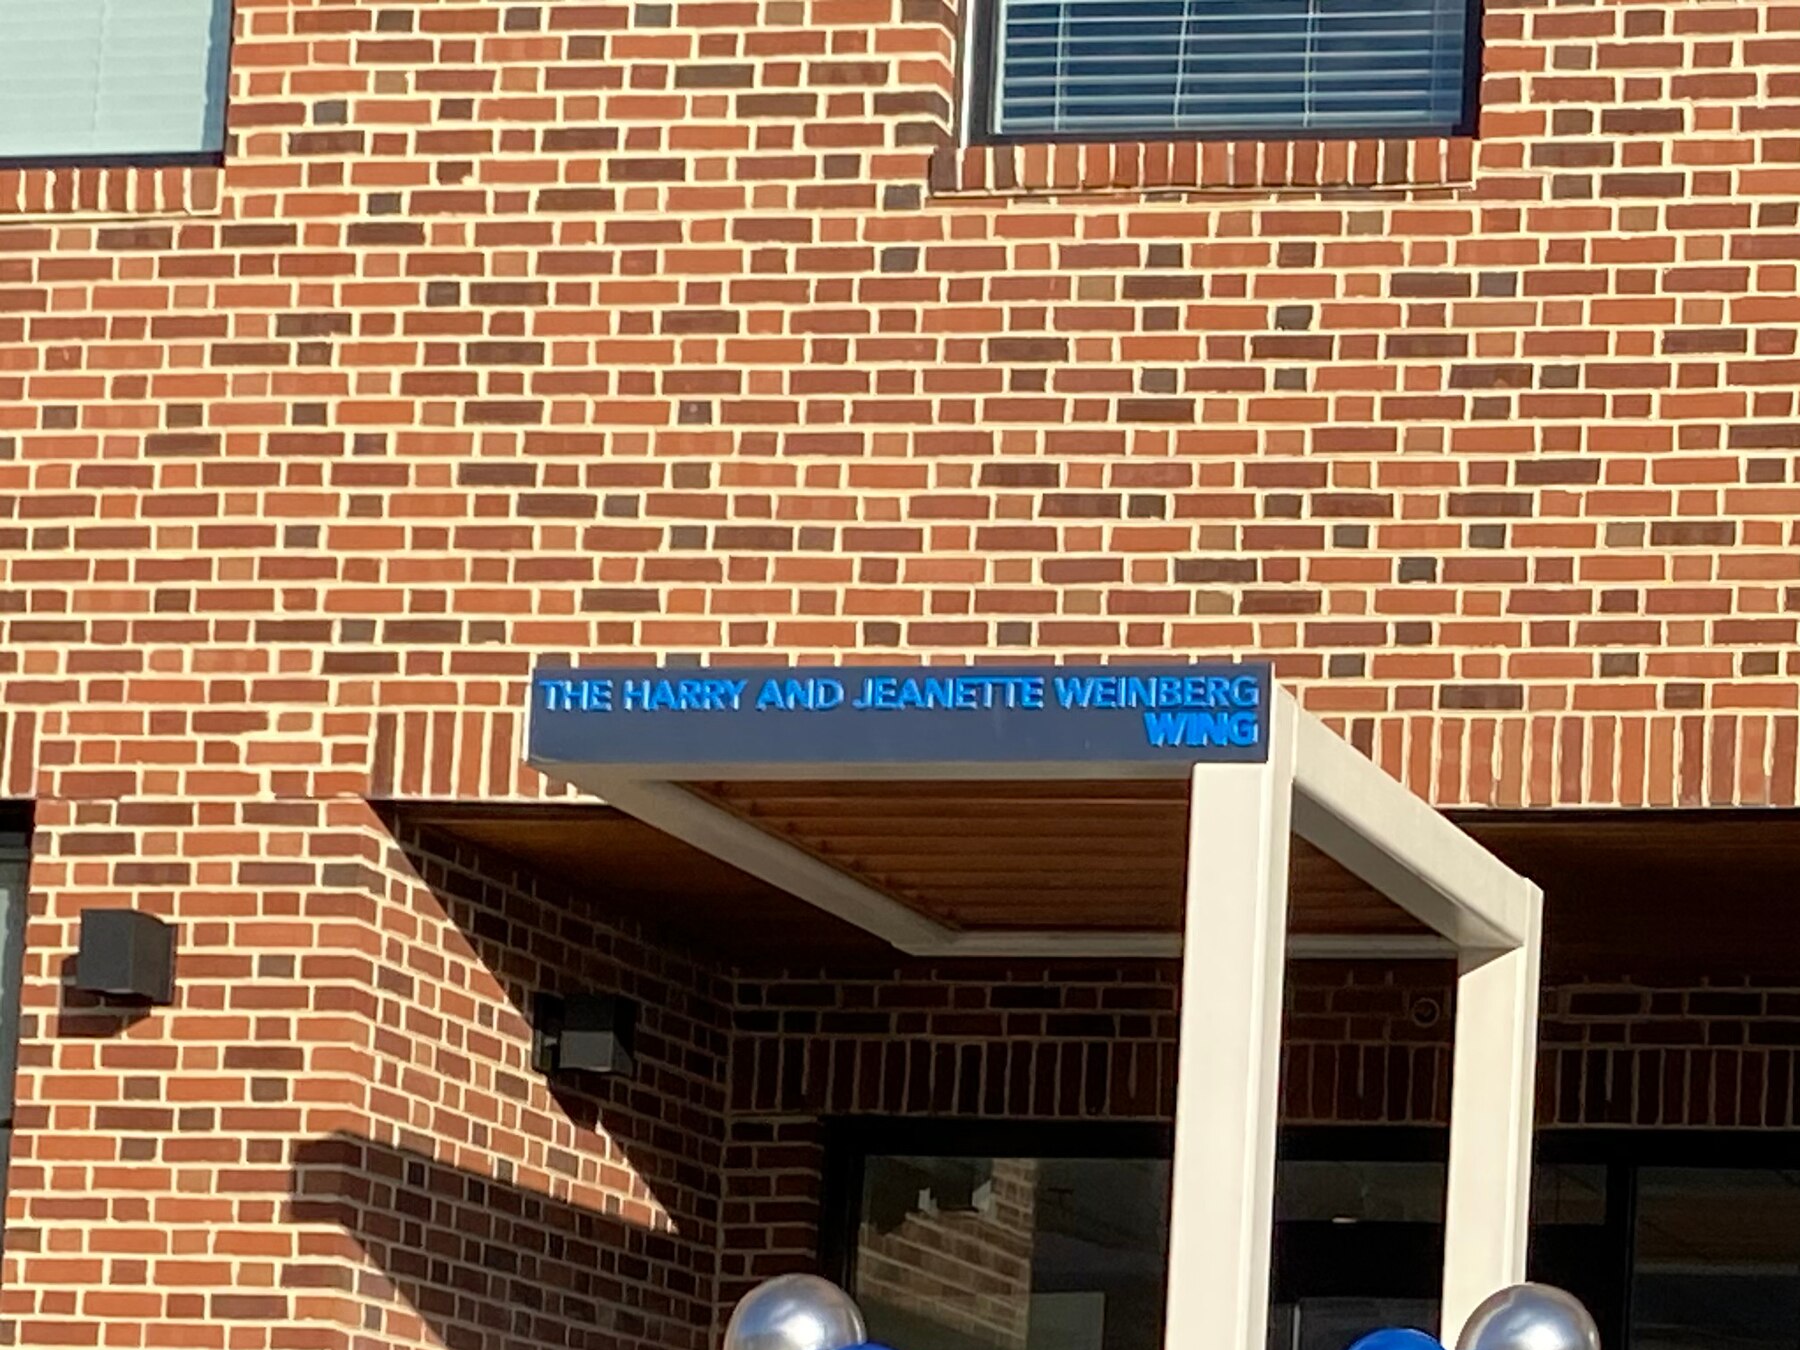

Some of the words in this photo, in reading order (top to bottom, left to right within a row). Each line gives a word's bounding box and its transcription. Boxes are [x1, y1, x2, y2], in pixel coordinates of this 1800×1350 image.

[539, 678, 613, 711] THE
[623, 678, 748, 711] HARRY
[756, 678, 844, 711] AND
[853, 676, 1044, 710] JEANETTE
[1053, 675, 1260, 709] WEINBERG
[1143, 711, 1260, 746] WING
